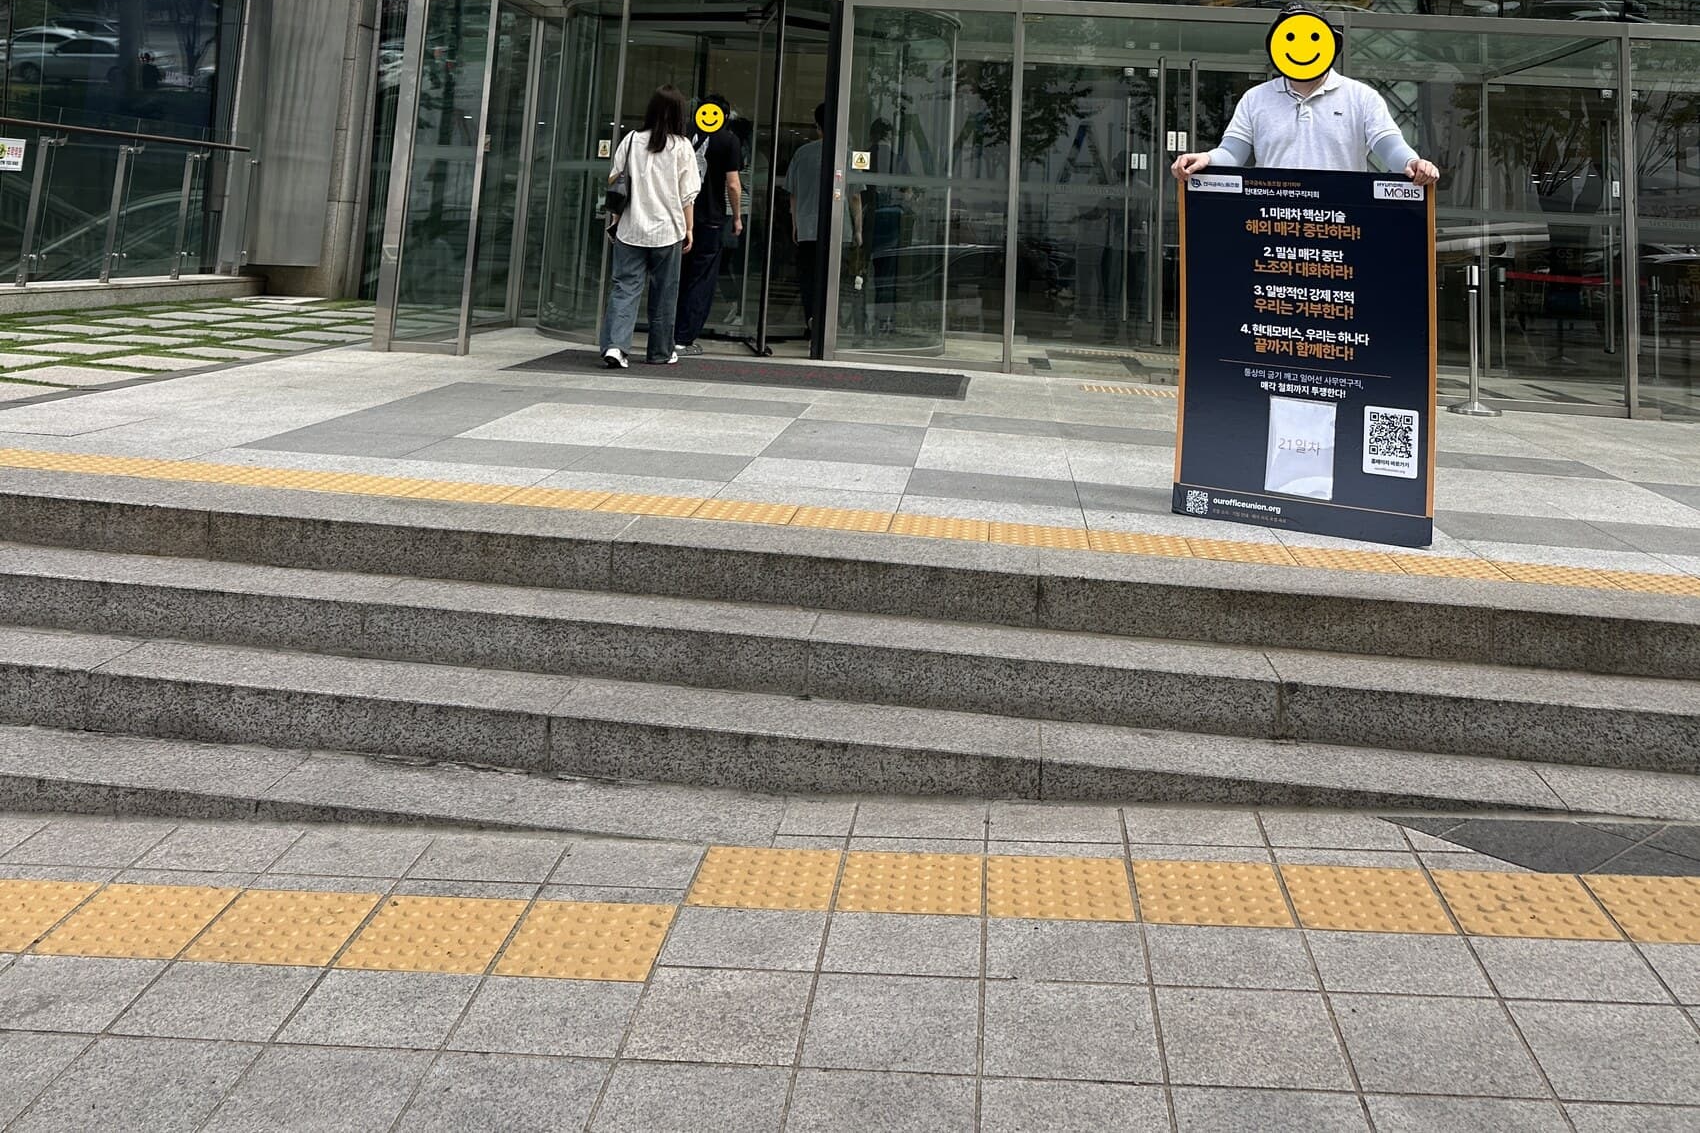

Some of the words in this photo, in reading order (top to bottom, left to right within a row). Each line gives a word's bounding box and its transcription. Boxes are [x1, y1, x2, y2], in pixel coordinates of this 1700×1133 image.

[1244, 187, 1275, 197] 현대모비스
[1384, 188, 1420, 199] MOBIS
[1260, 207, 1269, 218] 1.
[1270, 207, 1302, 221] 미래차
[1302, 208, 1346, 223] 핵심기술
[1245, 219, 1271, 235] 해외
[1274, 221, 1300, 237] 매각
[1303, 223, 1361, 240] 중단하라!
[1263, 247, 1274, 257] 2.
[1275, 247, 1297, 260] 밀실
[1298, 248, 1320, 261] 매각
[1321, 249, 1344, 263] 중단
[1253, 259, 1293, 276] 노조와
[1295, 262, 1353, 280] 대화하라!
[1253, 285, 1265, 296] 3.
[1265, 285, 1308, 300] 일방적인
[1309, 288, 1331, 302] 강제
[1332, 290, 1355, 304] 전적
[1254, 298, 1294, 315] 우리는
[1296, 302, 1354, 320] 거부한다!
[1240, 323, 1251, 334] 4.
[1252, 323, 1304, 341] 현대모비스,
[1305, 328, 1336, 343] 우리는
[1337, 331, 1370, 346] 하나다
[1254, 337, 1293, 355] 끝까지
[1296, 340, 1354, 361] 함께한다!
[1260, 381, 1277, 392] 매각
[1278, 382, 1310, 395] 철회까지
[1311, 386, 1346, 399] 투쟁한다!
[1213, 497, 1281, 515] ourofficeunion.org
